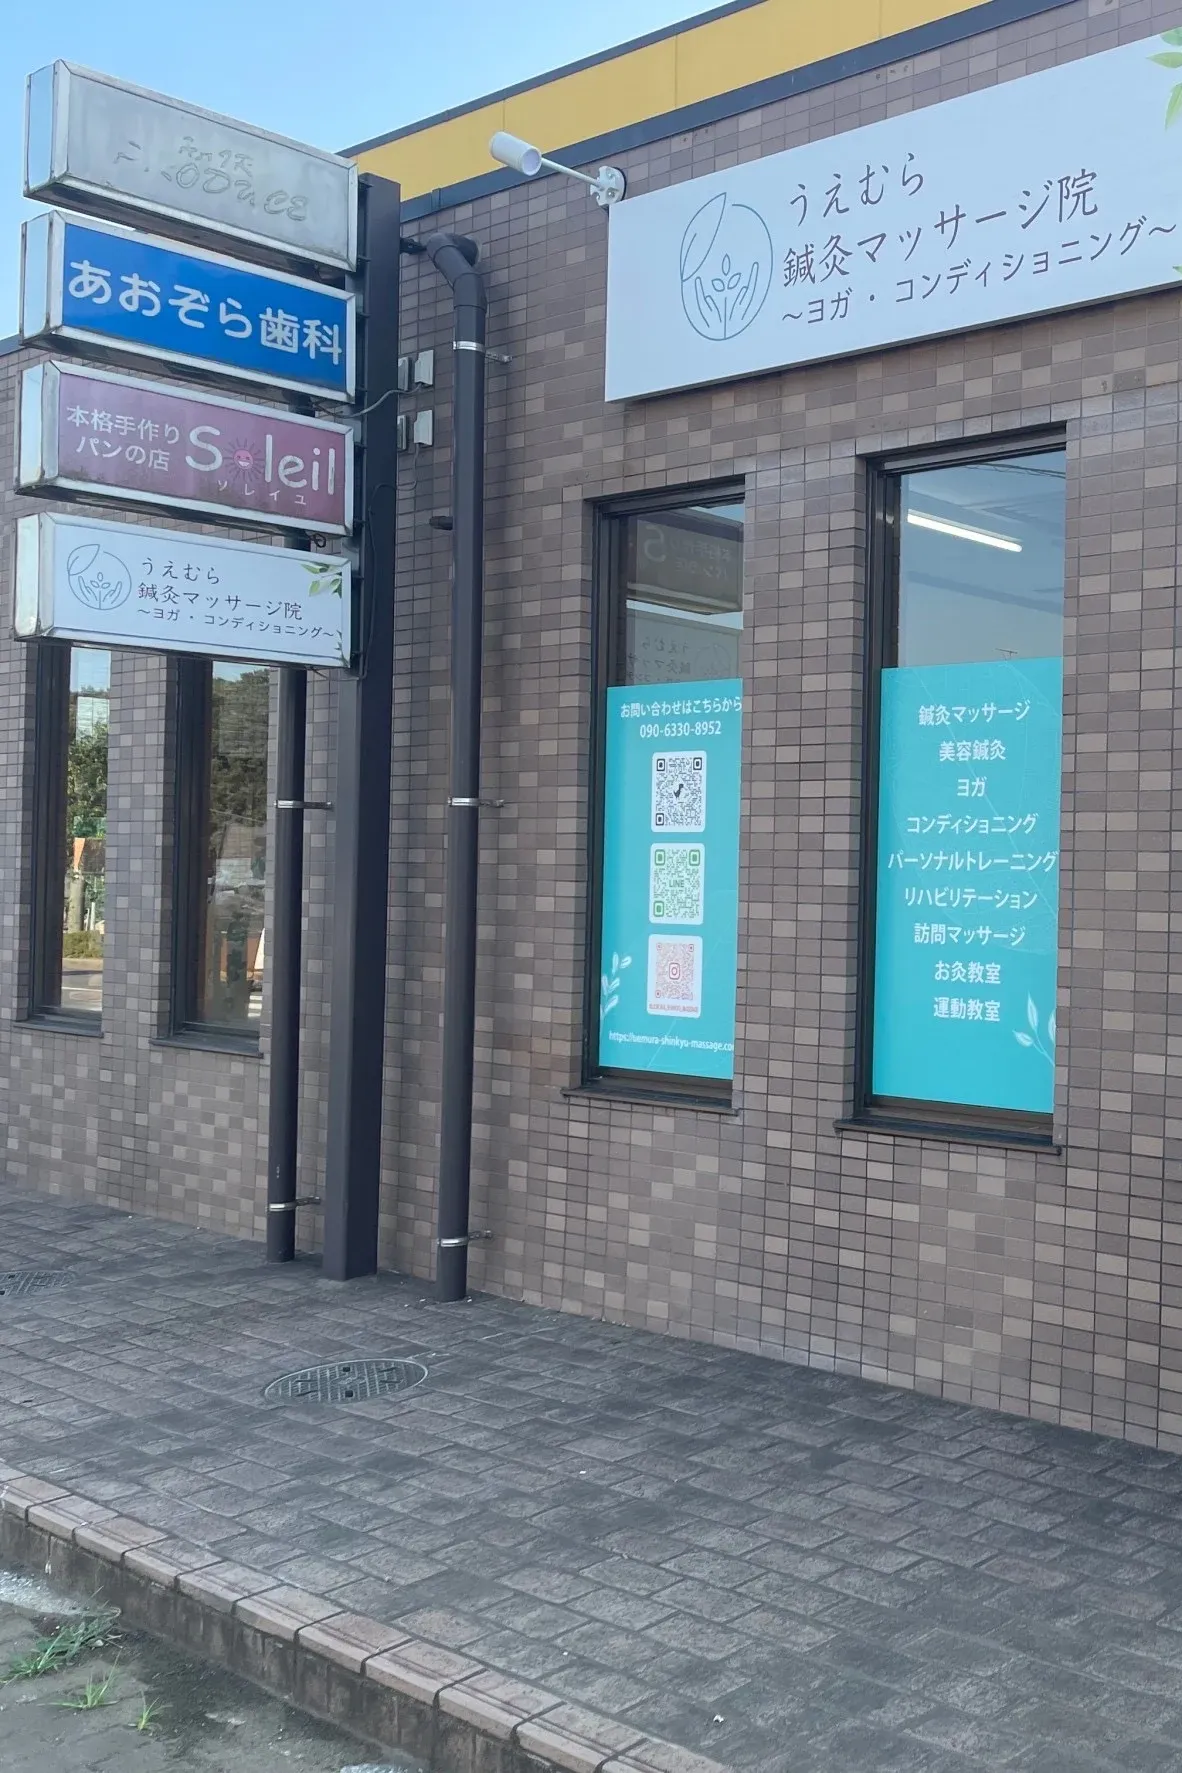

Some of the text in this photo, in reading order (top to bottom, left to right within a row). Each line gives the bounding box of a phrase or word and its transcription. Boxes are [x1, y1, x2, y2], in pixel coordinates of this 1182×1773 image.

[790, 152, 924, 227] うえむら
[782, 168, 1098, 288] 鍼灸マッサージ院
[68, 260, 342, 365] あおぞら歯科
[66, 405, 181, 444] 本格手作り
[76, 436, 171, 472] パンの店
[217, 479, 307, 505] ソレイユ
[142, 557, 221, 585] うえむら
[138, 582, 303, 621] 鍼灸マッサージ院
[620, 697, 742, 718] お問い合わせはこちらから
[919, 699, 1031, 726] 鍼灸マッサージ
[639, 721, 722, 738] 090-6330-8952
[939, 739, 1006, 762] 美容鍼灸
[957, 776, 987, 797] ヨガ
[907, 812, 1039, 834] コンディショニング
[888, 849, 1060, 873] パーソナルトレーニング
[905, 887, 1038, 909] リハビリテーション
[914, 922, 1026, 946] 訪問マッサージ
[934, 960, 1001, 984] お灸教室
[933, 996, 1000, 1022] 運動教室
